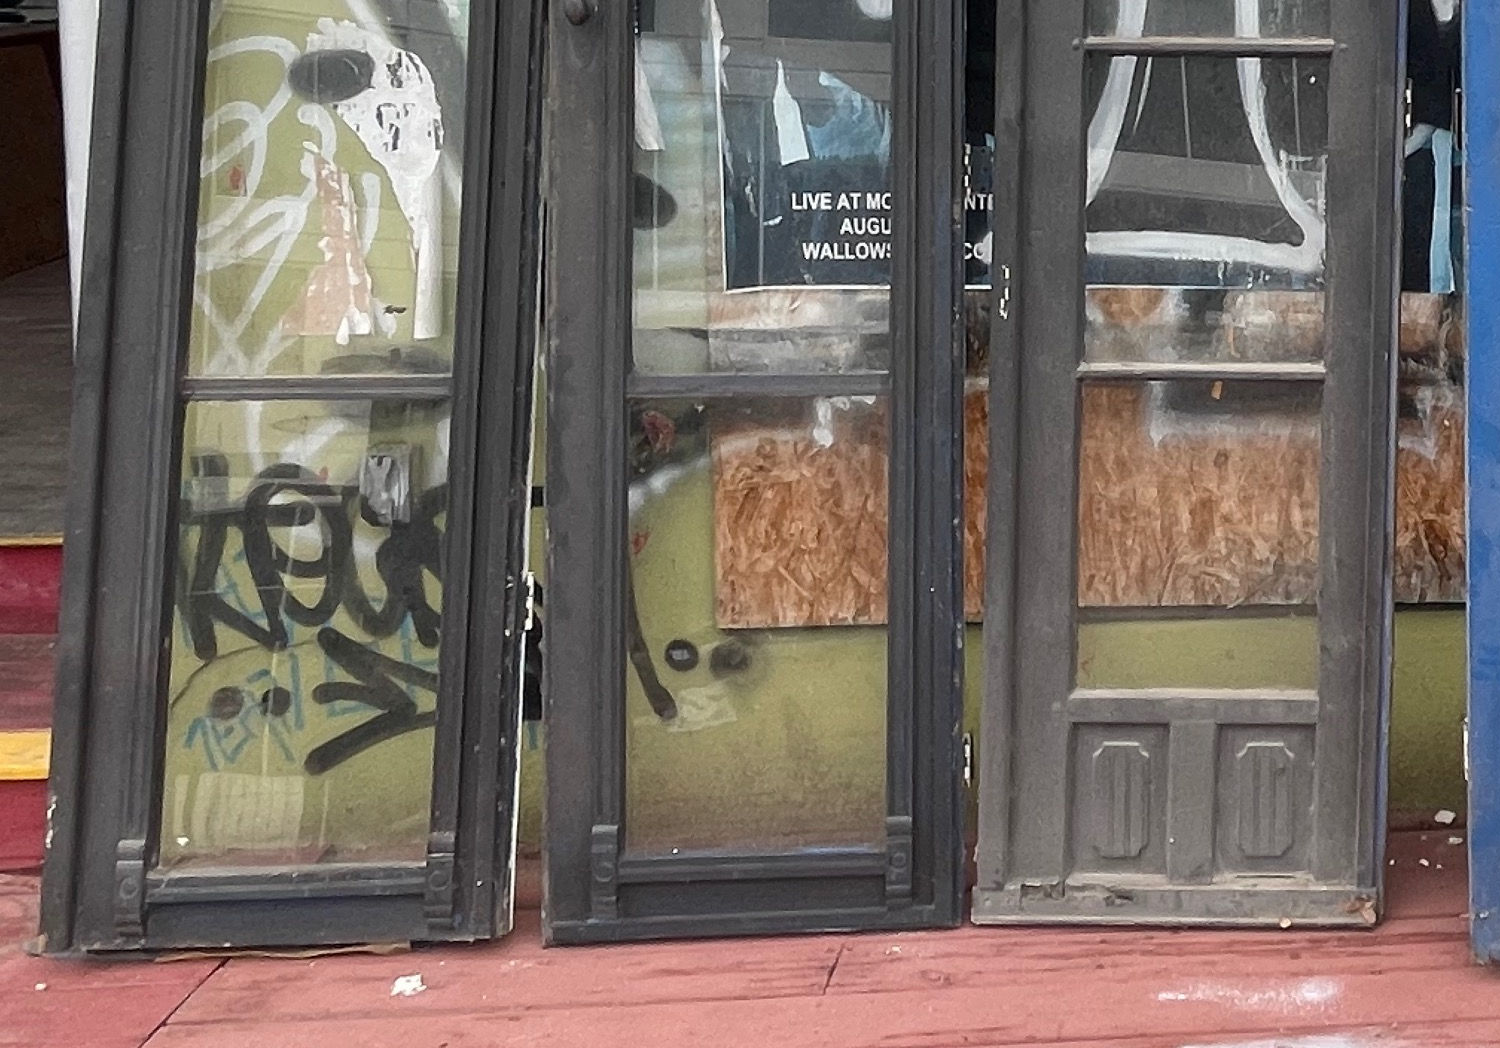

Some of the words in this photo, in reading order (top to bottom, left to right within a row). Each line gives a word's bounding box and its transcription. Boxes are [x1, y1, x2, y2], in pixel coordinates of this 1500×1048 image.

[791, 192, 832, 210] LIVE
[837, 192, 861, 210] AT
[840, 217, 892, 235] AUGU
